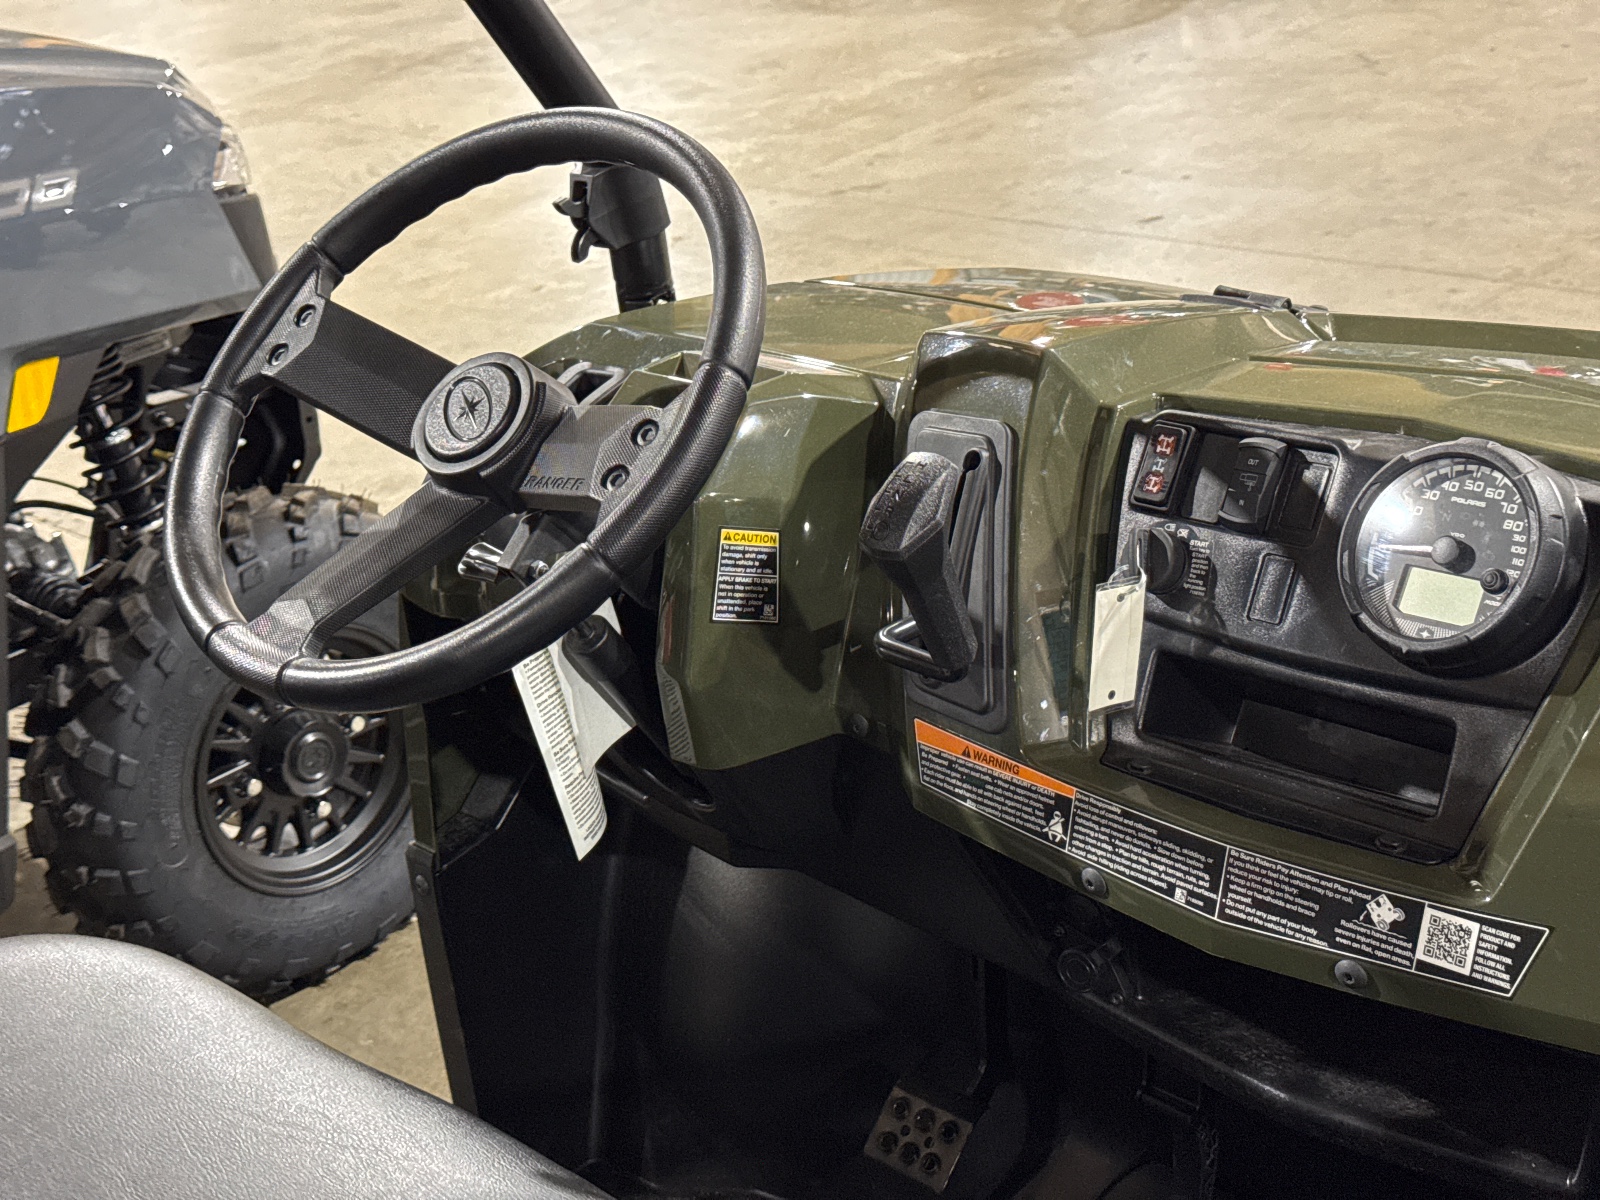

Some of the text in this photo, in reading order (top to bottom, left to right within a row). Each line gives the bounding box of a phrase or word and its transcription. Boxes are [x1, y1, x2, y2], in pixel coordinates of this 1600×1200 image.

[524, 476, 585, 490] RANGER
[1441, 481, 1460, 492] 40
[1463, 480, 1484, 492] 50
[1421, 489, 1440, 500] 30
[1484, 488, 1505, 499] 60
[1451, 496, 1486, 508] POLARIS
[1501, 502, 1518, 514] 70
[1503, 519, 1524, 532] 80
[733, 532, 776, 544] CAUTION
[1512, 534, 1526, 542] 90
[1511, 545, 1527, 554] 100
[1512, 558, 1525, 566] 110
[1506, 569, 1520, 578] 120
[973, 749, 1020, 775] WARNING
[1076, 792, 1122, 814] Drive Responsibly
[1227, 866, 1248, 877] reduce
[1248, 874, 1262, 882] your
[1230, 850, 1372, 900] Be Sure Riders Pay Attention and Plan Ahead
[1233, 860, 1245, 868] you
[1246, 863, 1260, 872] think
[1290, 878, 1311, 889] vehicle
[1311, 886, 1325, 895] may
[1325, 889, 1334, 898] tip
[1229, 883, 1247, 894] wheel
[1254, 892, 1285, 907] handholds
[1286, 902, 1298, 911] and
[1297, 906, 1316, 917] brace
[1230, 875, 1246, 886] Keep
[1251, 882, 1263, 891] firm
[1263, 886, 1275, 896] grip
[1284, 893, 1294, 901] the
[1294, 897, 1320, 911] steering
[1224, 908, 1247, 920] outside
[1253, 917, 1264, 925] the
[1264, 920, 1285, 932] vehicle
[1286, 927, 1295, 936] for
[1295, 932, 1306, 941] any
[1226, 899, 1235, 907] Do
[1235, 902, 1245, 910] not
[1245, 906, 1256, 915] put
[1256, 910, 1267, 919] any
[1267, 913, 1280, 923] part
[1287, 921, 1301, 931] your
[1301, 925, 1318, 936] body
[1334, 927, 1356, 938] severe
[1356, 933, 1380, 948] injuries
[1380, 942, 1394, 951] and
[1340, 919, 1413, 949] Rollovers have caused
[1482, 925, 1521, 942] SCAN CODE FOR
[1478, 941, 1498, 951] SAFETY
[1480, 933, 1516, 949] PRODUCT AND
[1335, 937, 1351, 946] even
[1374, 949, 1391, 961] open
[1475, 956, 1496, 967] FOLLOW
[1472, 972, 1483, 980] AND
[1473, 964, 1510, 980] INSTRUCTIONS
